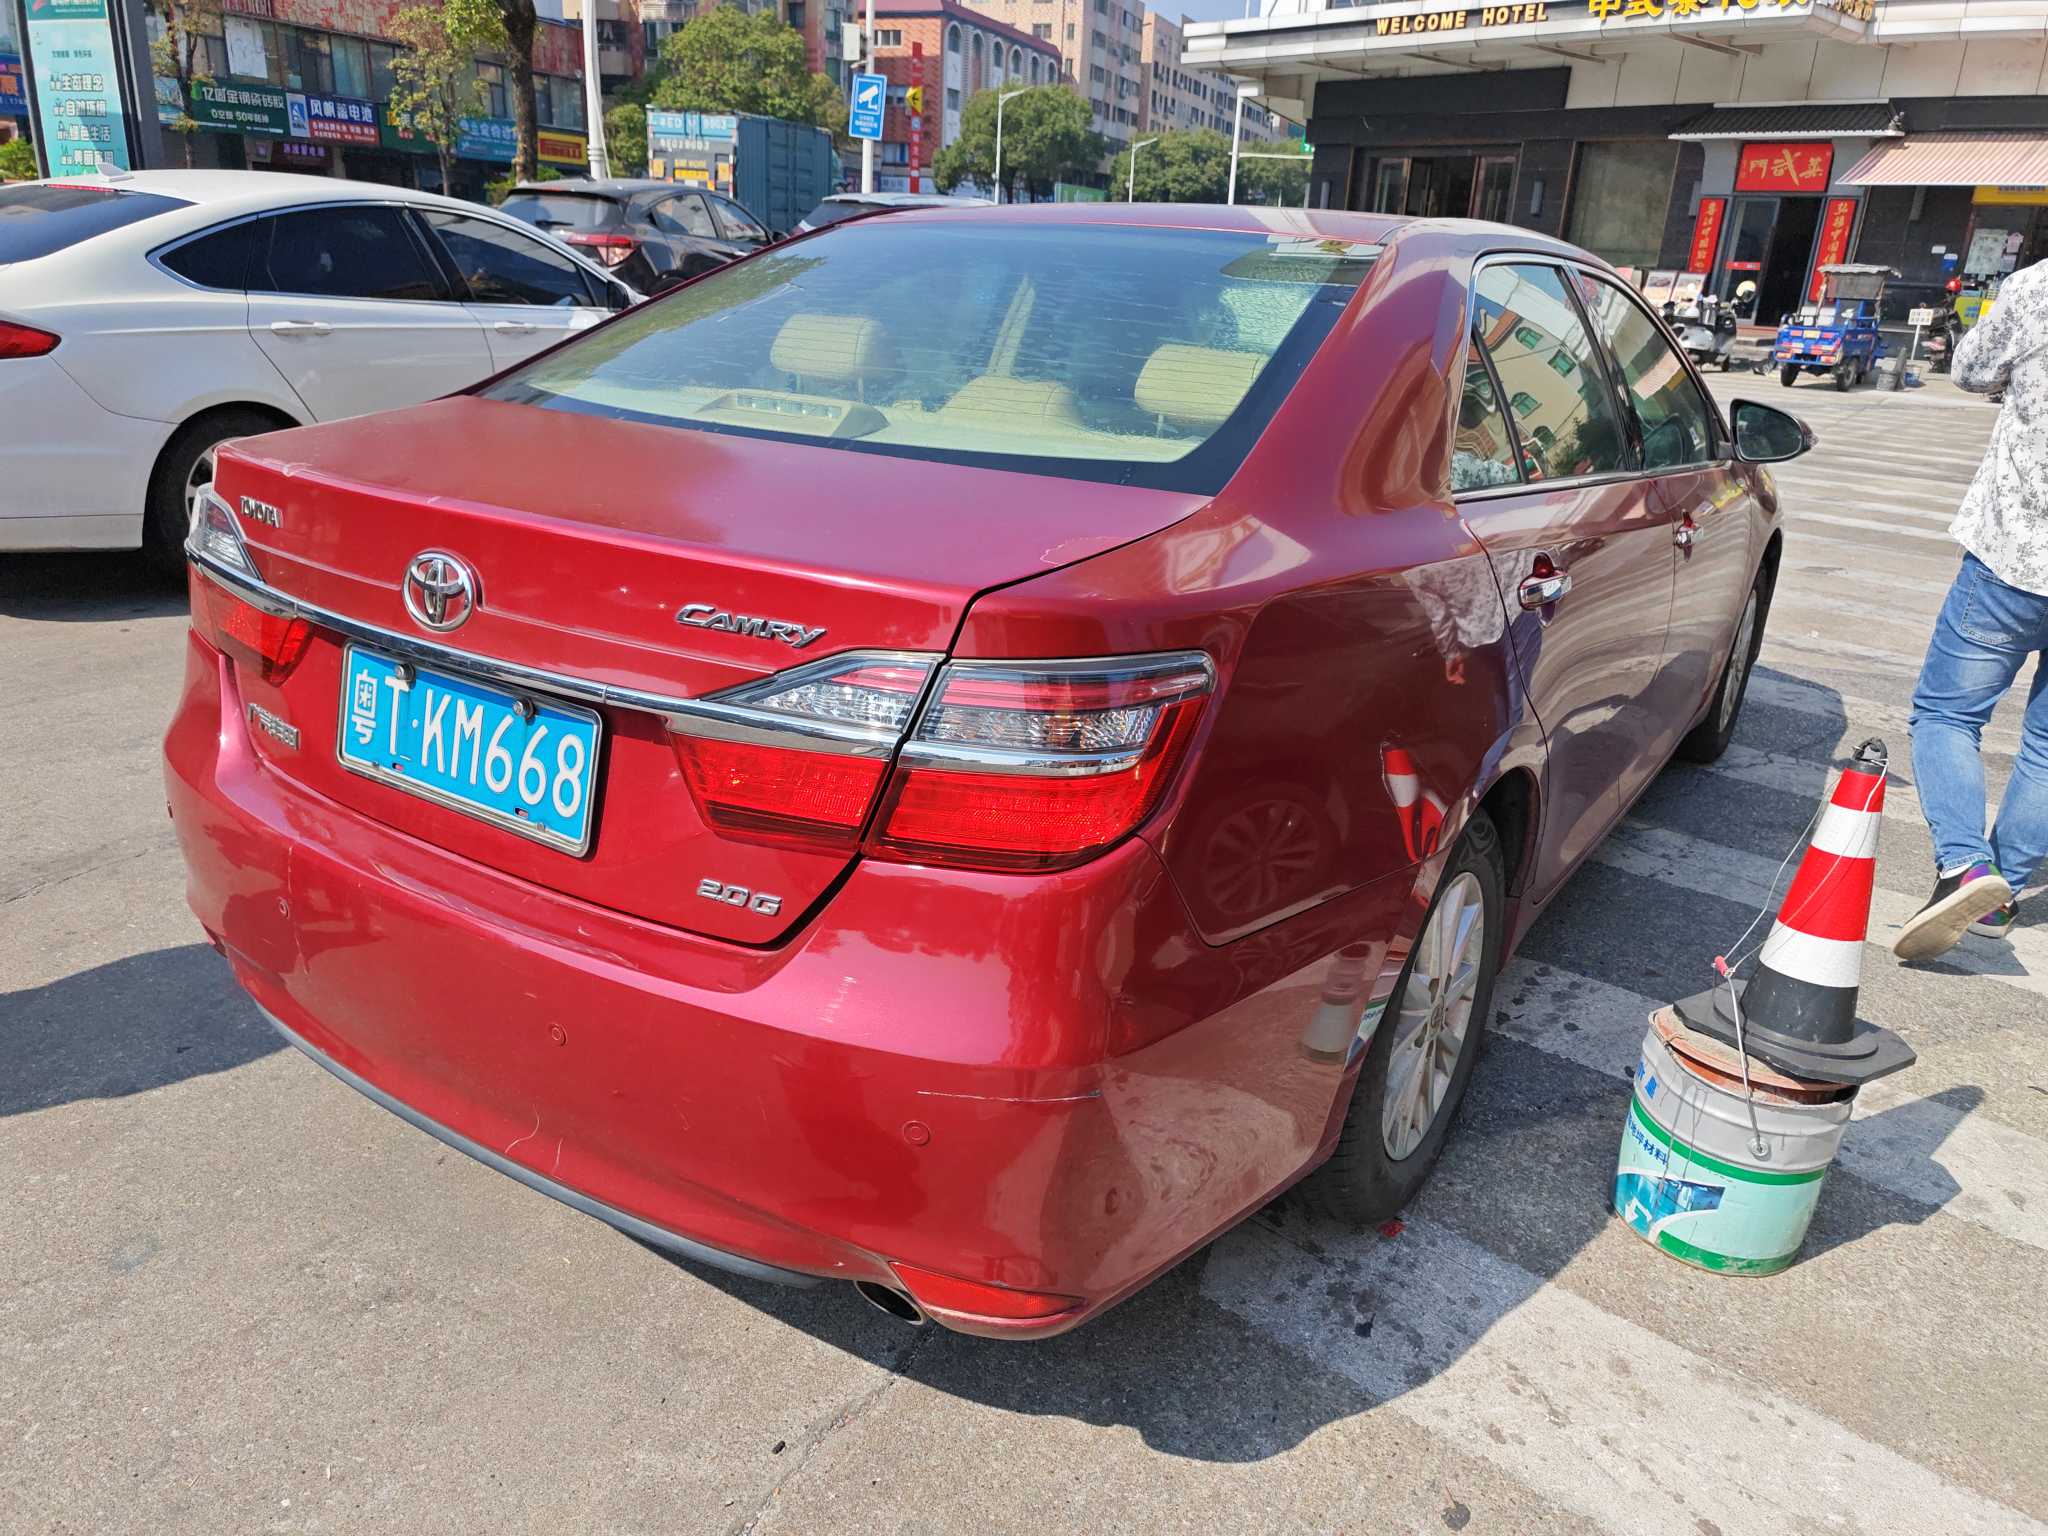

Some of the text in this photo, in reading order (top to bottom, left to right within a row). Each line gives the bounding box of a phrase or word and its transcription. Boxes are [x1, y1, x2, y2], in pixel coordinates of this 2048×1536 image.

[1376, 3, 1549, 36] WELCOME HOTEL
[310, 98, 374, 123] 风帆蓄电池
[240, 495, 284, 529] TOYOTA
[675, 602, 828, 649] CAMRY
